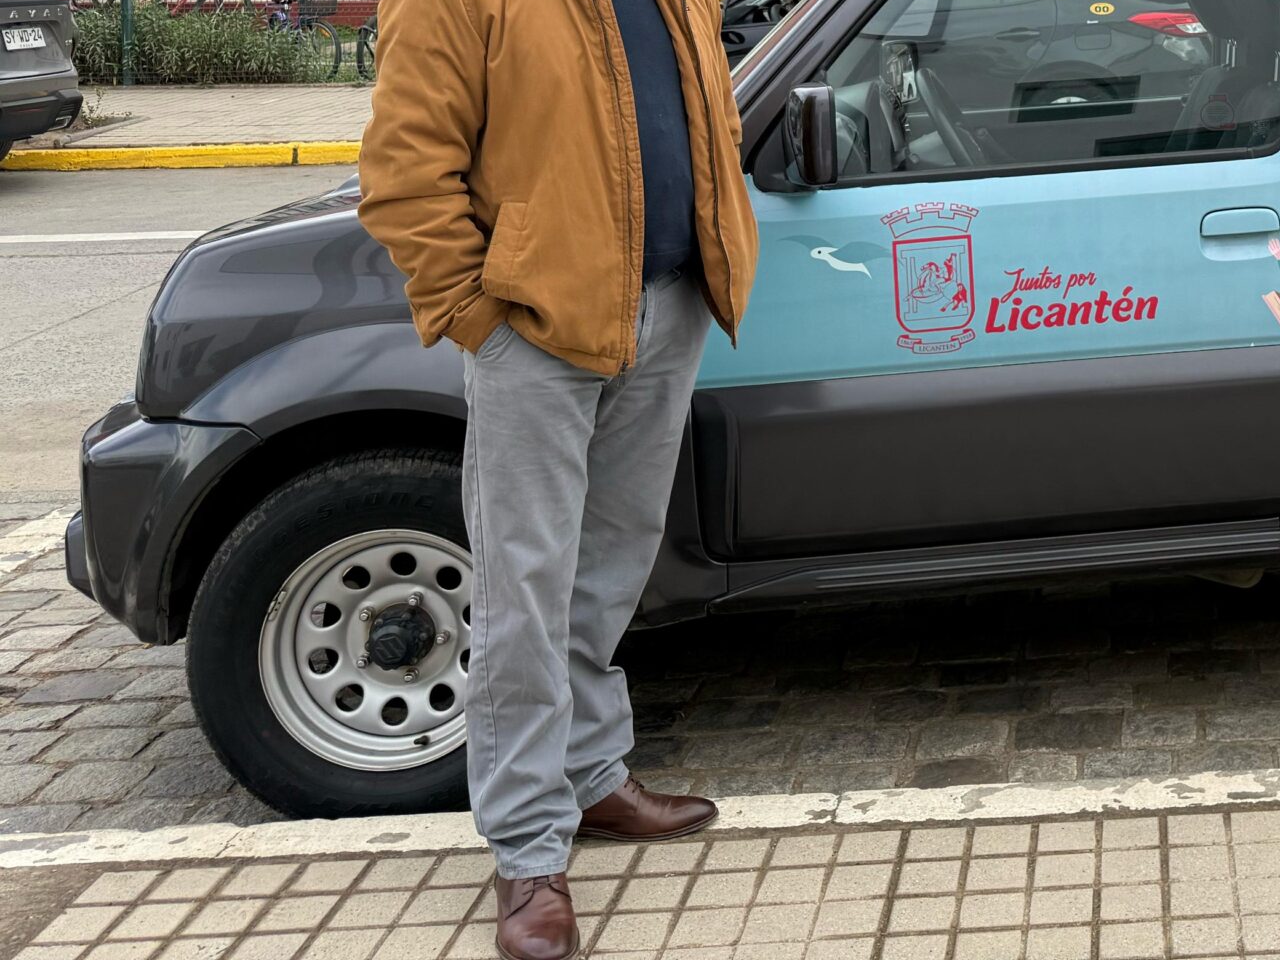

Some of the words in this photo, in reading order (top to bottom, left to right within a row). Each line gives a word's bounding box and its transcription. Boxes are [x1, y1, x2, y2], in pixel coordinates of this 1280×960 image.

[1000, 266, 1062, 304] Juntos
[1062, 272, 1097, 300] por
[985, 286, 1159, 333] Licantén
